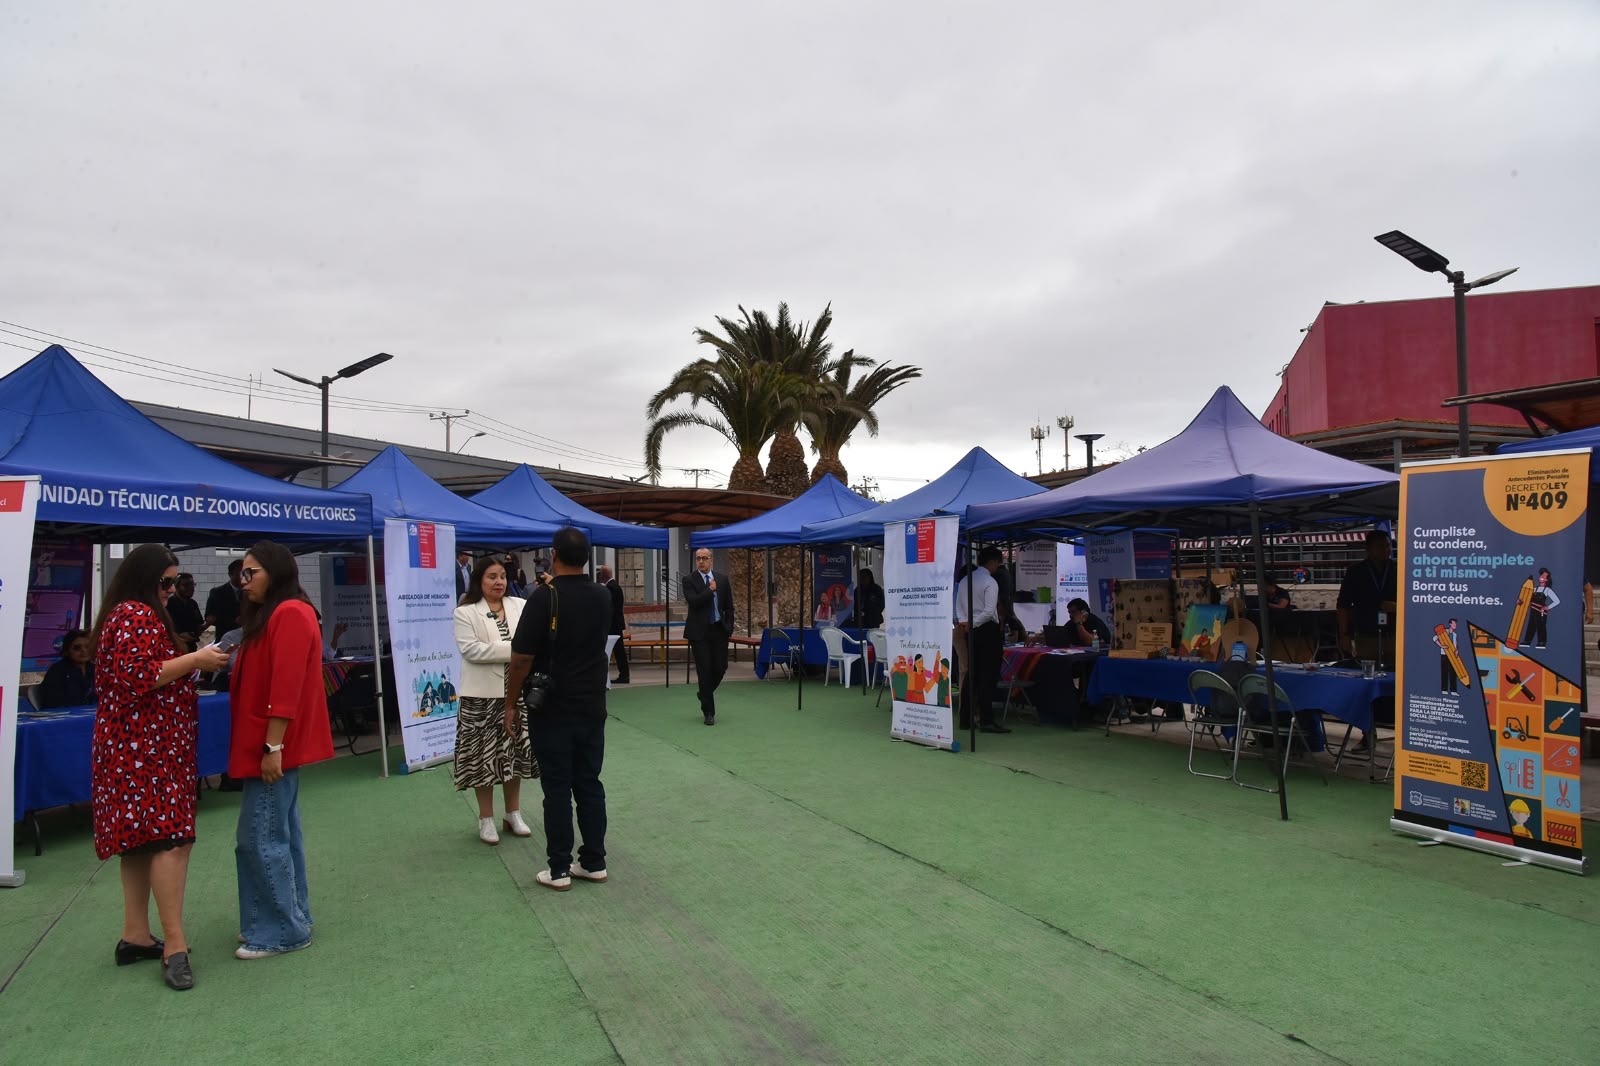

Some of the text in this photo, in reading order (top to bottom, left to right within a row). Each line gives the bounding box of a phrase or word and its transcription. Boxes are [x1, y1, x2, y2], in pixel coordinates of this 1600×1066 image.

[108, 488, 180, 512] TÉCNICA
[184, 496, 204, 513] DE
[208, 498, 281, 518] ZOONOSIS
[284, 505, 292, 519] Y
[294, 505, 356, 521] VECTORES
[1414, 526, 1476, 540] Cumpliste
[1414, 539, 1487, 550] tu condena,
[1412, 552, 1534, 569] ahora cúmplete
[1412, 566, 1493, 578] a ti mismo.
[1412, 580, 1468, 592] Borra tus
[1412, 594, 1504, 606] antecedentes.
